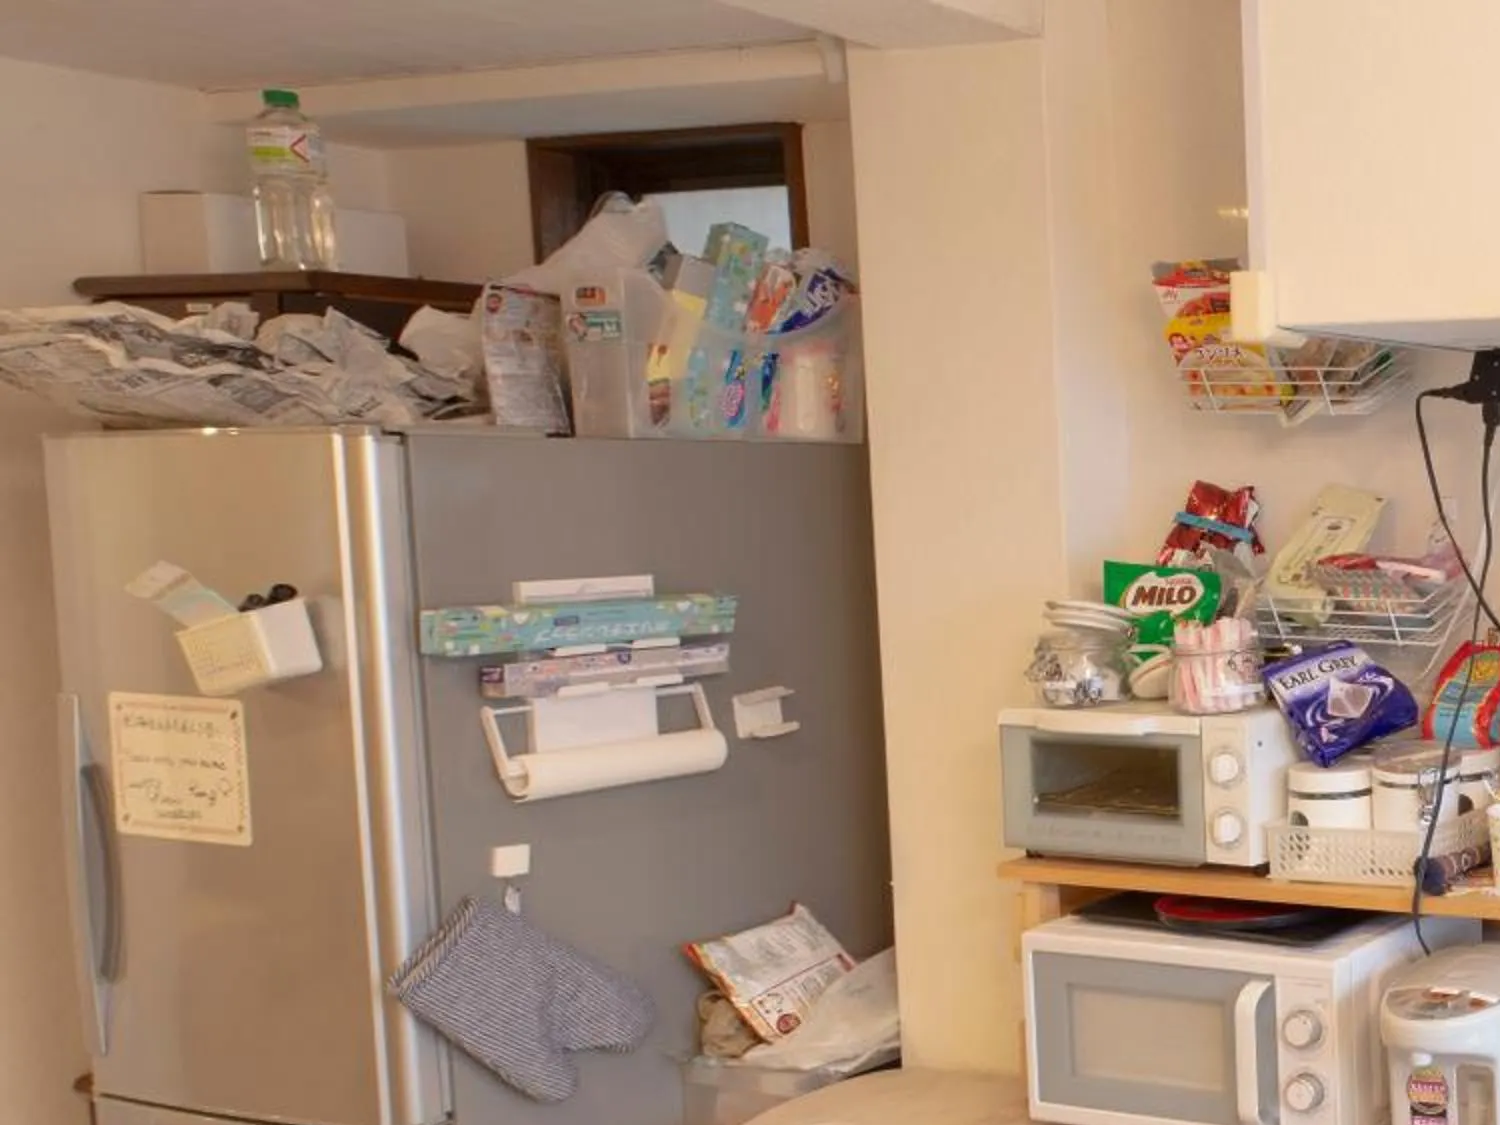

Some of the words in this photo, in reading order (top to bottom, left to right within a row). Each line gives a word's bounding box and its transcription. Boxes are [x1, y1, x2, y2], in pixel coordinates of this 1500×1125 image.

[1131, 585, 1197, 606] MILO
[1279, 669, 1319, 691] EARL
[1317, 656, 1357, 674] GREY
